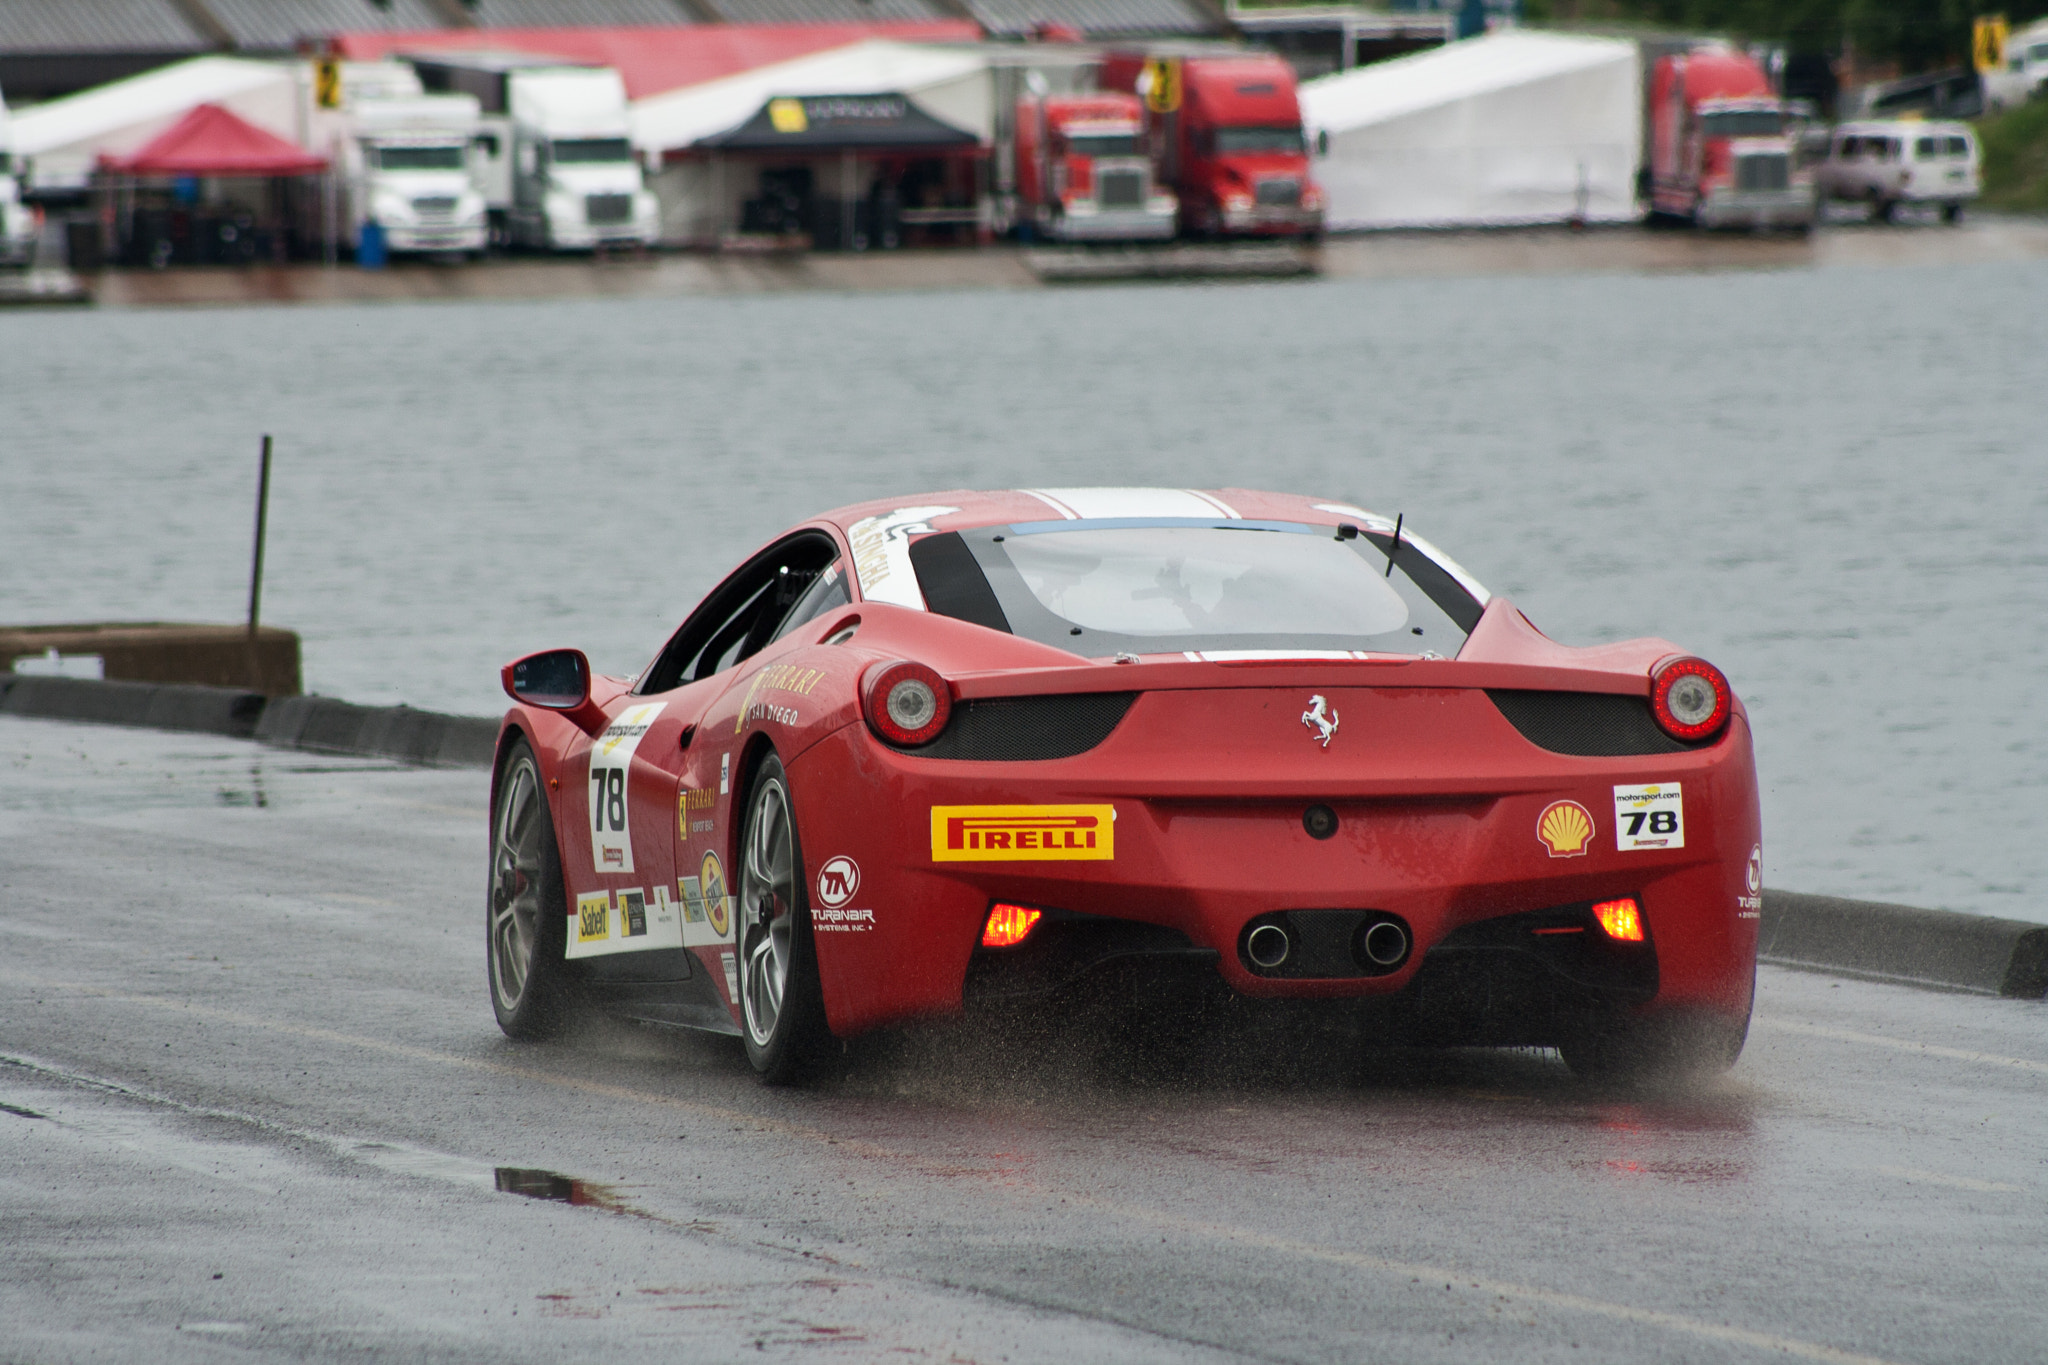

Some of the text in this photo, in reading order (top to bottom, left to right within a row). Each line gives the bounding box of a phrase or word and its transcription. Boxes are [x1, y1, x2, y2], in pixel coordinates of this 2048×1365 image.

[758, 664, 827, 696] FERRARI
[767, 704, 798, 727] DIEGO
[591, 767, 626, 832] 78
[687, 787, 715, 810] FERRARI
[1616, 792, 1680, 803] motorsport.com
[947, 816, 1098, 850] PIRELLI
[1620, 811, 1678, 836] 78
[581, 903, 607, 937] Sabelt
